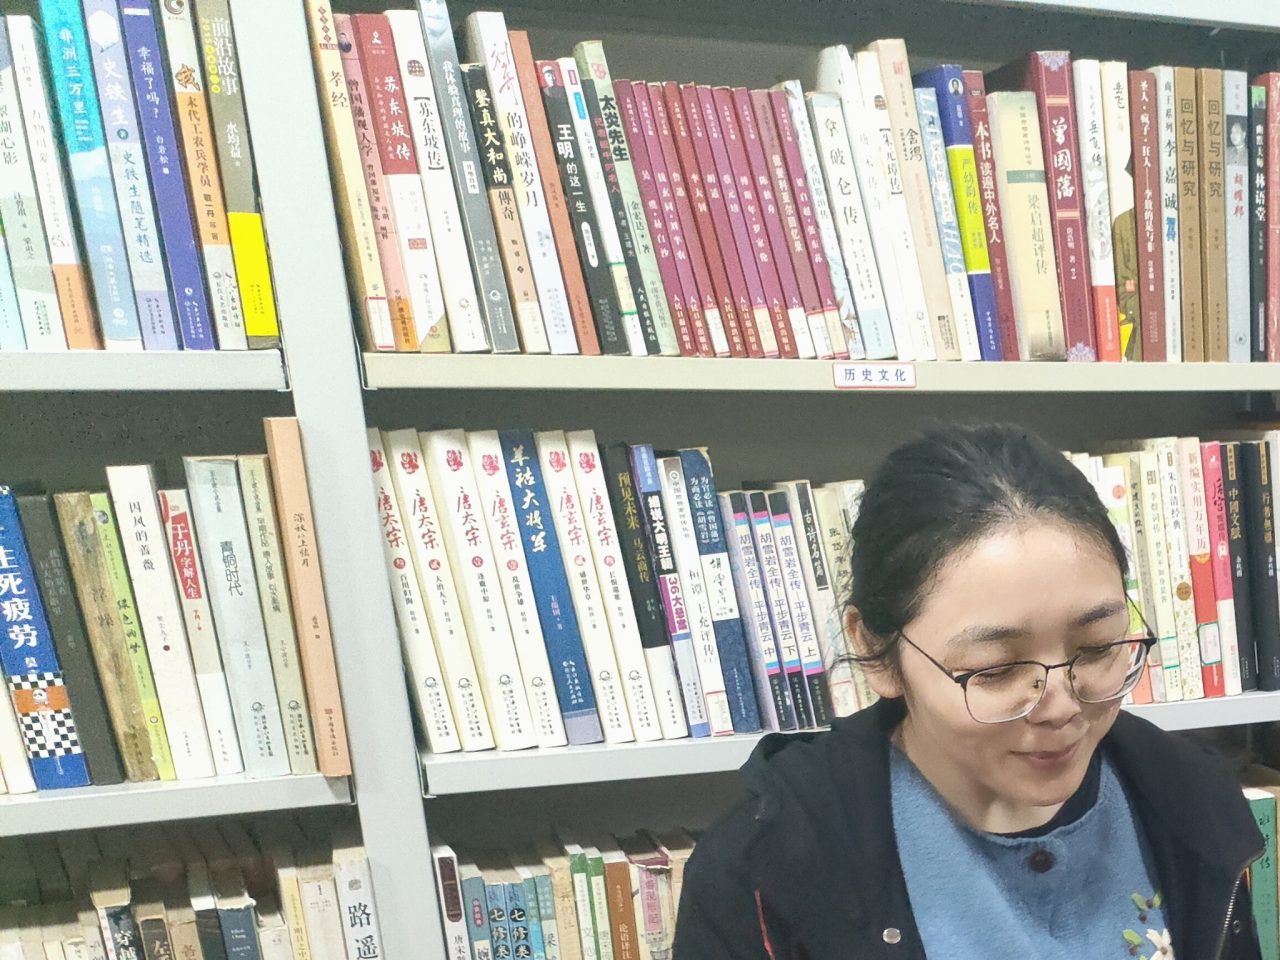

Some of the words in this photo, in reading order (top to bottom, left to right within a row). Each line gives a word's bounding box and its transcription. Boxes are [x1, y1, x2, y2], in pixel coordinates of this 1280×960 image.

[211, 17, 239, 97] 前沿故事
[103, 57, 129, 126] 史铁生
[383, 75, 412, 161] 苏东坡传
[186, 95, 213, 188] 末代工农兵学员
[599, 94, 630, 162] 太炎先生
[1180, 98, 1197, 197] 回忆与研究
[1207, 100, 1222, 198] 回忆与研究
[972, 109, 1002, 245] 一本书读遍中外名人
[1255, 173, 1267, 222] 林语堂
[843, 368, 907, 382] 历史文化
[377, 485, 405, 549] 唐太宗
[412, 488, 440, 550] 唐太宗
[457, 485, 483, 547] 唐太宗
[492, 489, 519, 551] 唐玄宗
[560, 486, 586, 547] 唐玄宗
[589, 487, 615, 547] 唐玄宗
[616, 471, 640, 530] 预见未来
[1188, 452, 1207, 550] 新编实用万年历
[171, 523, 201, 599] 于丹字解人生
[219, 540, 244, 597] 青铜时代
[0, 544, 39, 650] 生死疲劳
